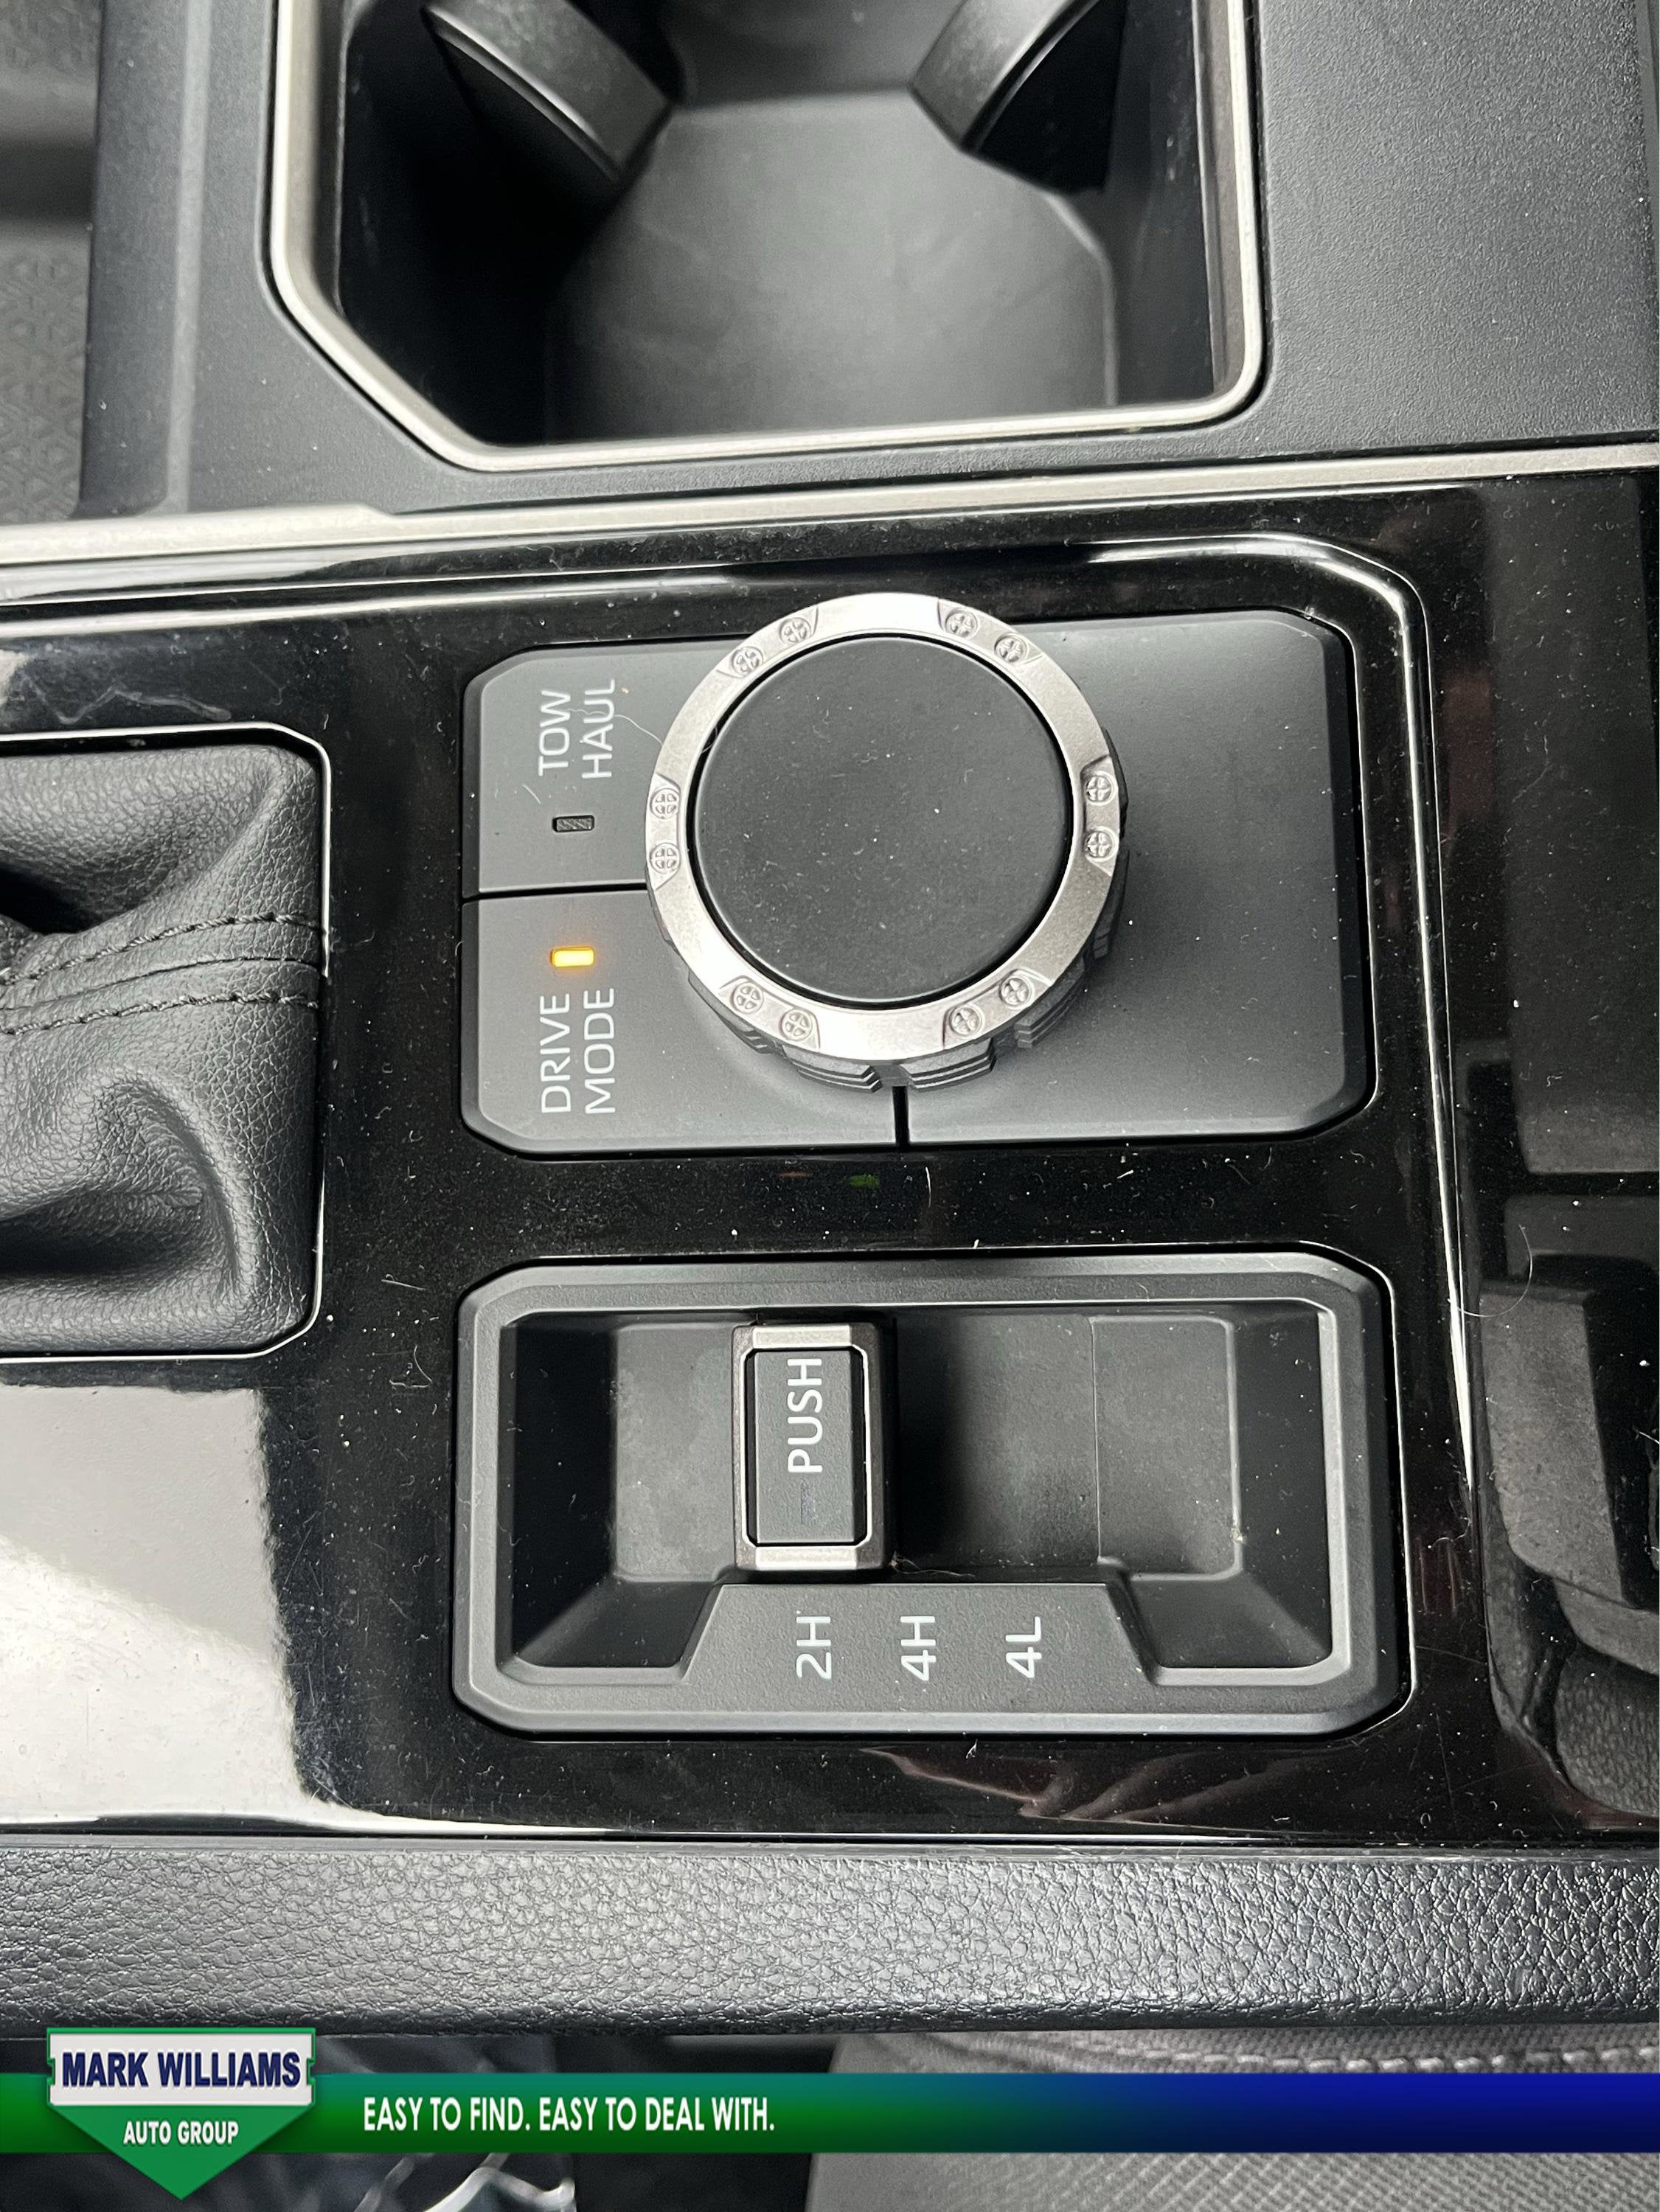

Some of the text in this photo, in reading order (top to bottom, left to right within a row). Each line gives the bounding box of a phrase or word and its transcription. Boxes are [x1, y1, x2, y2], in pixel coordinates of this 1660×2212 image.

[538, 689, 572, 776] TOW
[582, 679, 616, 779] HAUL
[541, 992, 572, 1113] DRIVE
[584, 987, 616, 1115] MODE
[787, 1357, 823, 1473] PUSH
[796, 1615, 832, 1680] 2H
[900, 1615, 937, 1681] 4H
[1005, 1615, 1043, 1678] 4L
